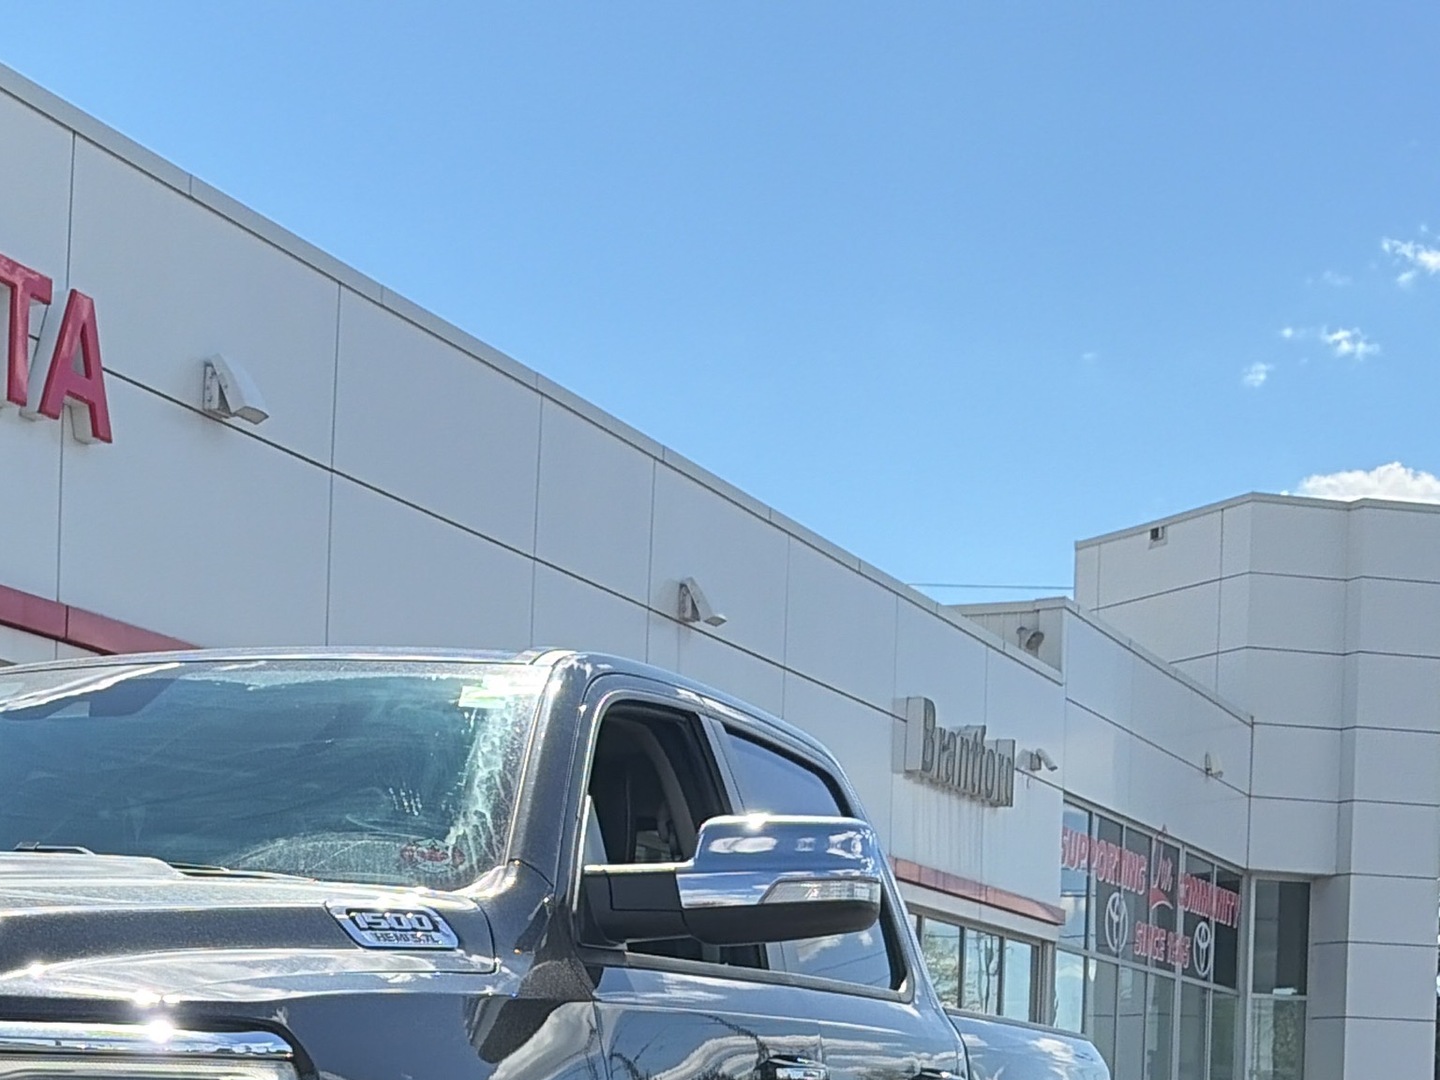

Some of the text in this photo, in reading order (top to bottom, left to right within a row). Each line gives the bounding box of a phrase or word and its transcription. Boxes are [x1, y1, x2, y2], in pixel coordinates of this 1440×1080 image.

[910, 696, 1015, 807] Brantford
[1061, 827, 1148, 895] SUPPORTING
[349, 910, 434, 931] 1500
[374, 931, 409, 942] HEMI
[1133, 920, 1166, 962] SINCE
